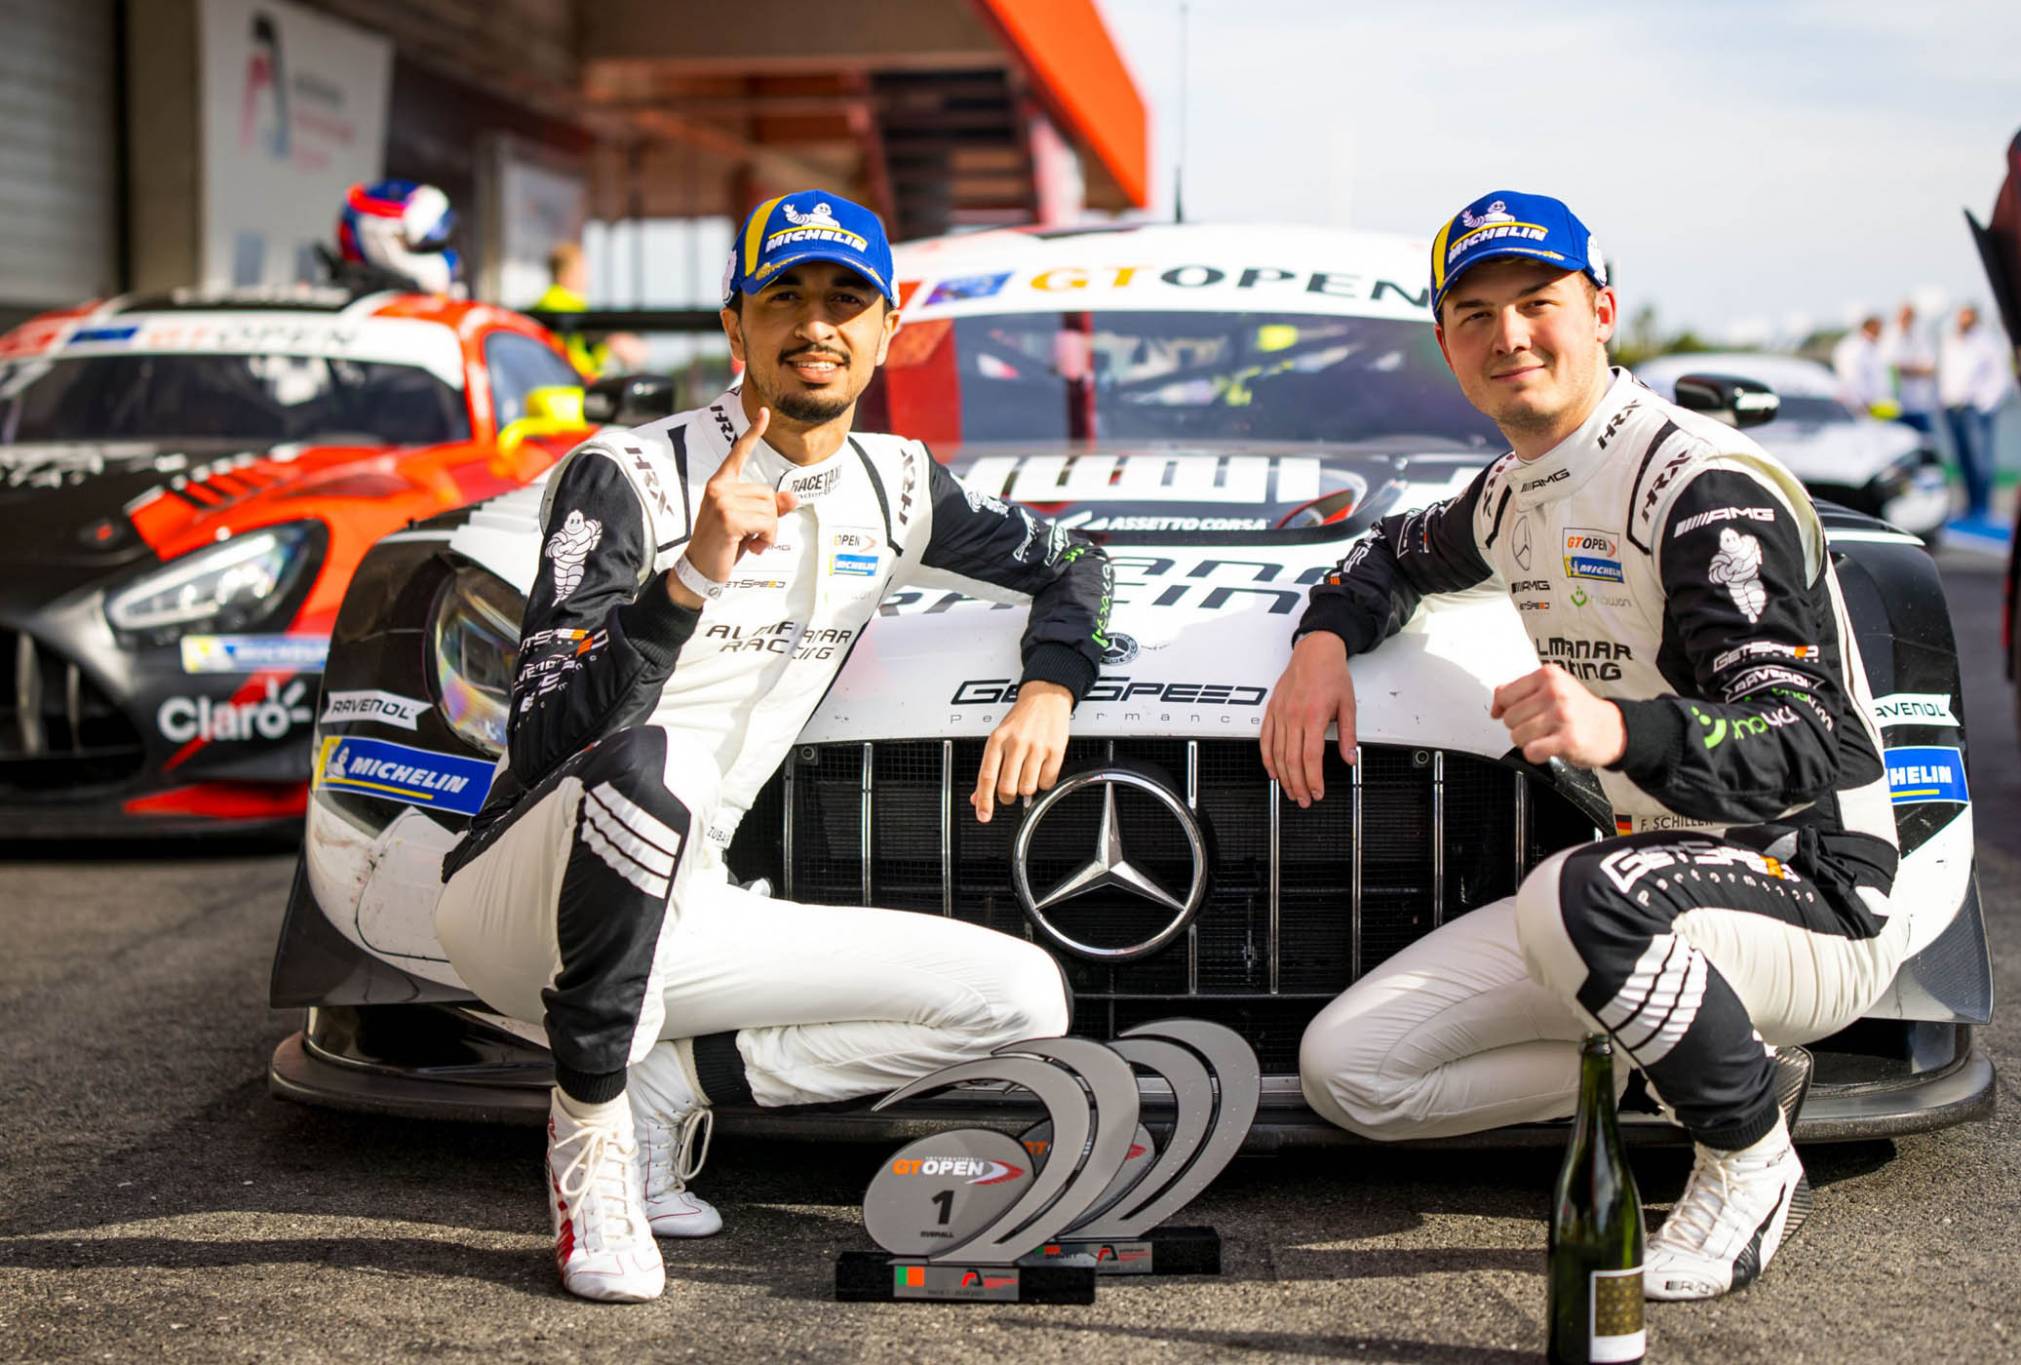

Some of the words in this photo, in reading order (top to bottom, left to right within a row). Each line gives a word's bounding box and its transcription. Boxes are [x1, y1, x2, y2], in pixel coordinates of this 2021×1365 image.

[765, 229, 869, 254] MICHELIN
[1449, 226, 1547, 264] MICHELIN
[1641, 449, 1692, 523] HRX
[1535, 636, 1634, 661] LMANAR
[156, 695, 292, 742] Claro
[331, 698, 411, 721] RAVENOL
[1874, 701, 1947, 719] AVENOL
[350, 756, 470, 795] MICHELIN
[1889, 765, 1953, 787] HELIN
[931, 1189, 955, 1225] 1
